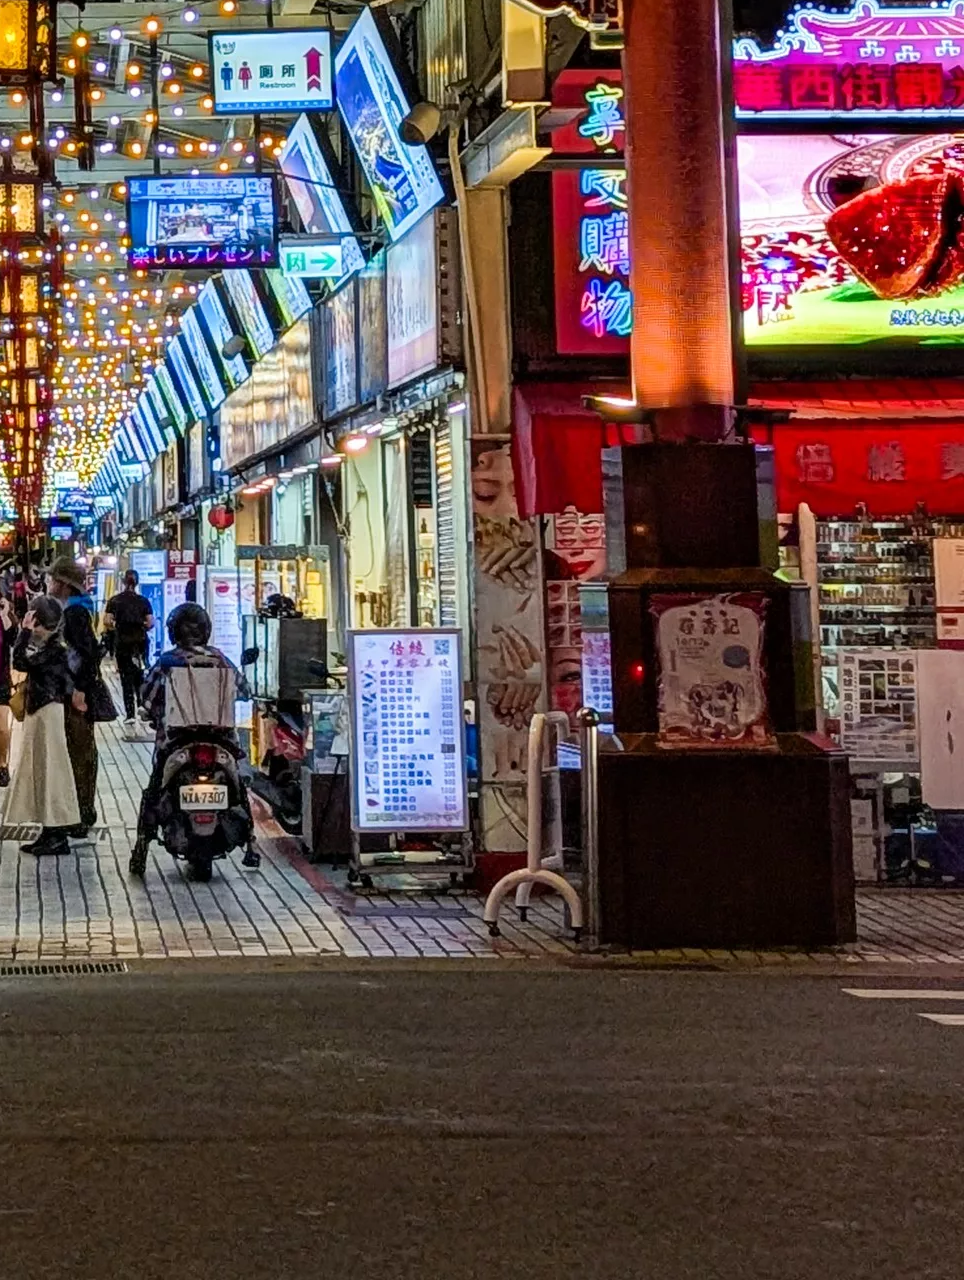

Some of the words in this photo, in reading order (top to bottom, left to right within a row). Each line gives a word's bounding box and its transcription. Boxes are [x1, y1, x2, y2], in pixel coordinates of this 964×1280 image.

[259, 64, 296, 78] 廁所
[133, 245, 272, 264] 楽しいプレゼント
